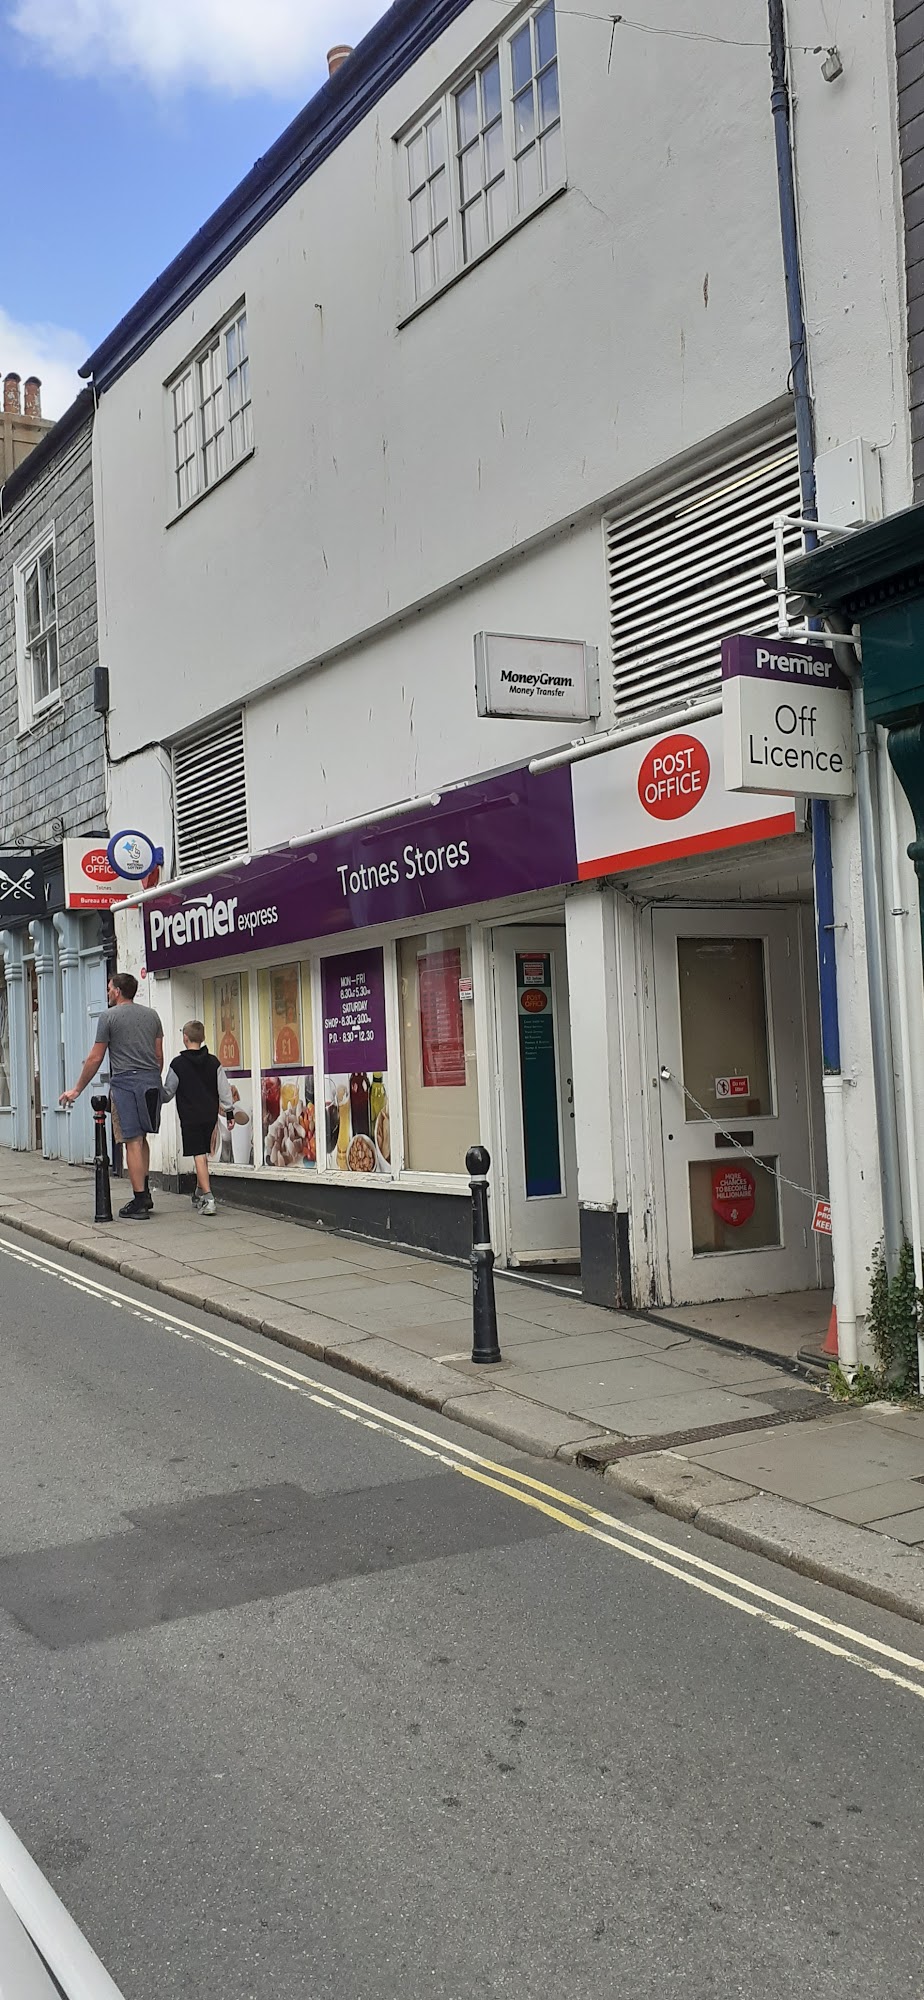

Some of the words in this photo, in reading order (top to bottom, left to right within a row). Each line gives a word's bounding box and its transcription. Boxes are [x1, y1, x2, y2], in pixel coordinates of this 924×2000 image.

[756, 648, 833, 678] Premier
[500, 670, 573, 687] MoneyGram
[509, 685, 535, 697] Money
[536, 687, 565, 697] Transfer
[775, 704, 817, 737] Off
[749, 734, 843, 773] Licence
[652, 747, 695, 779] POST
[644, 770, 702, 804] OFFICE
[91, 855, 110, 865] POS
[85, 864, 117, 874] OFFIC
[336, 860, 400, 896] Totnes
[403, 840, 470, 880] Stores
[149, 893, 238, 952] Premier
[237, 905, 279, 937] express
[342, 1000, 368, 1014] SATURDAY
[324, 1017, 339, 1029] SHOP
[223, 1044, 235, 1059] £10
[281, 1038, 291, 1055] £1
[720, 1178, 747, 1186] CHANCES
[724, 1172, 741, 1180] MORE
[716, 1190, 752, 1199] MILLIONAIRE
[723, 1184, 748, 1192] BECOME
